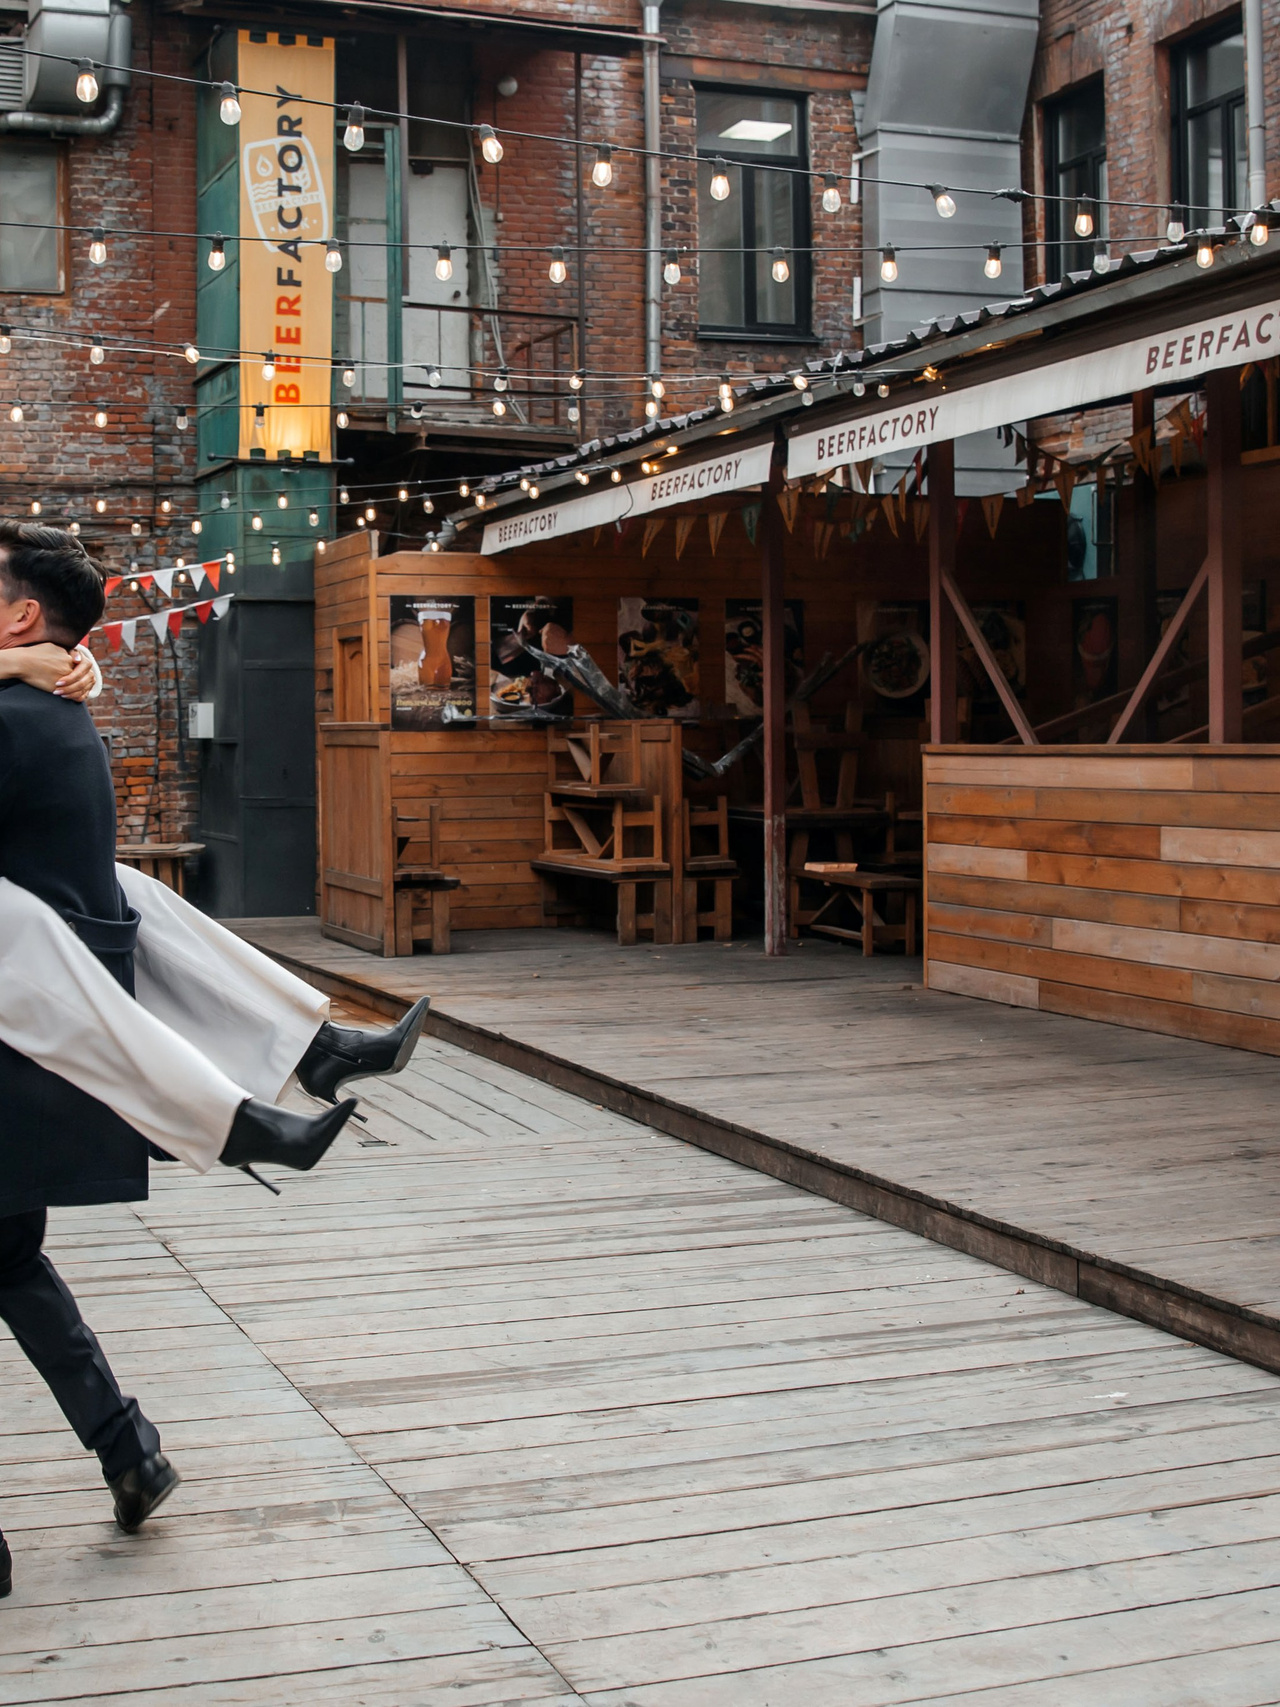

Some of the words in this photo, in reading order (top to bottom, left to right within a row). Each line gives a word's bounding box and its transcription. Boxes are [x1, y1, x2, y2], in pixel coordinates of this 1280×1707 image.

[275, 85, 303, 403] BEERFACTORY
[817, 405, 939, 460] BEERFACTORY
[650, 457, 742, 502] BEERFACTORY
[498, 511, 558, 543] BEERFACTORY
